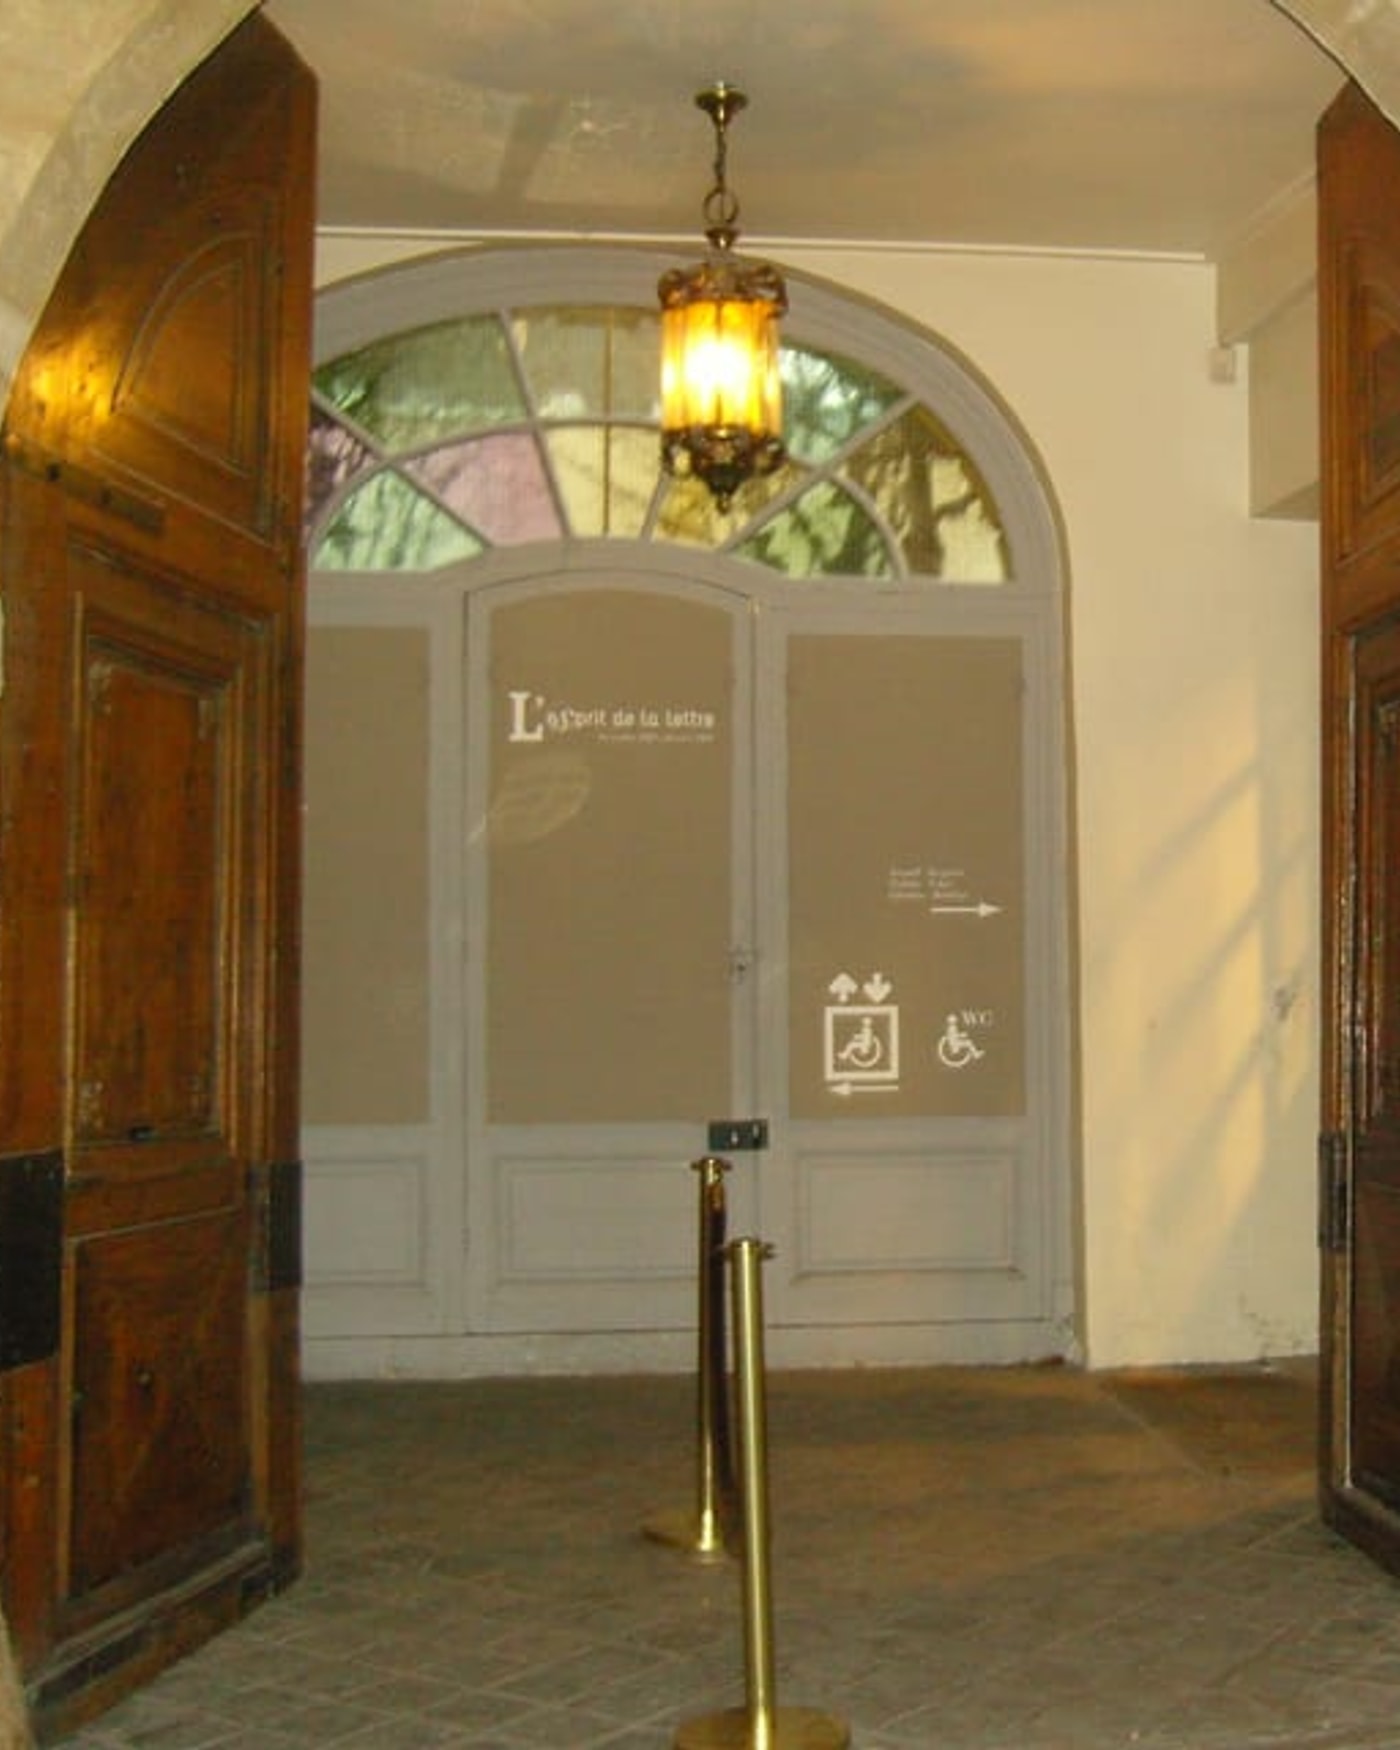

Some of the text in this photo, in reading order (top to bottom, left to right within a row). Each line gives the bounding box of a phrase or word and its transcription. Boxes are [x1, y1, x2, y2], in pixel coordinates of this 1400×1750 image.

[612, 707, 635, 727] de
[640, 707, 659, 727] la
[961, 1010, 993, 1026] WC
